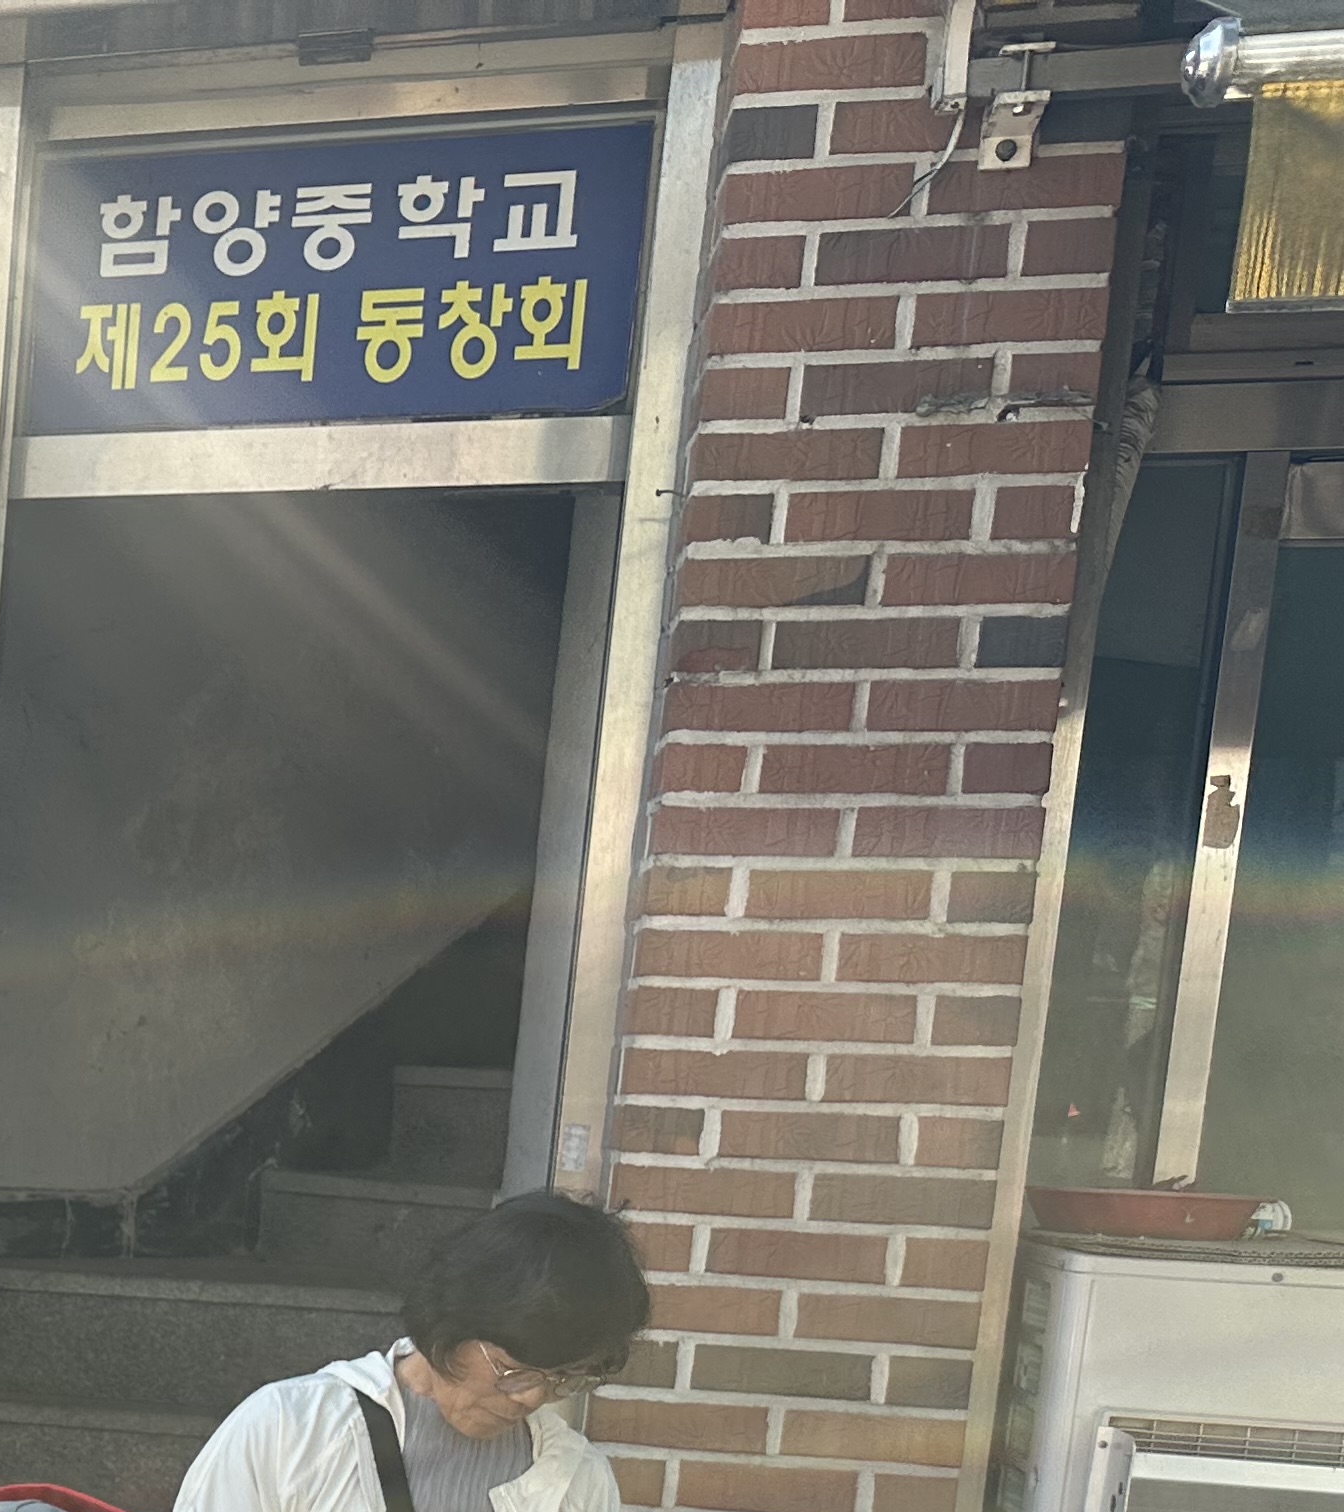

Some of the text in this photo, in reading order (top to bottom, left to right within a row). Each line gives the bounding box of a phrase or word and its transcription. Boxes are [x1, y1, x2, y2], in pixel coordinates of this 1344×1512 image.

[99, 169, 578, 278] 함양중학교
[76, 276, 588, 390] 제25회 동창회
